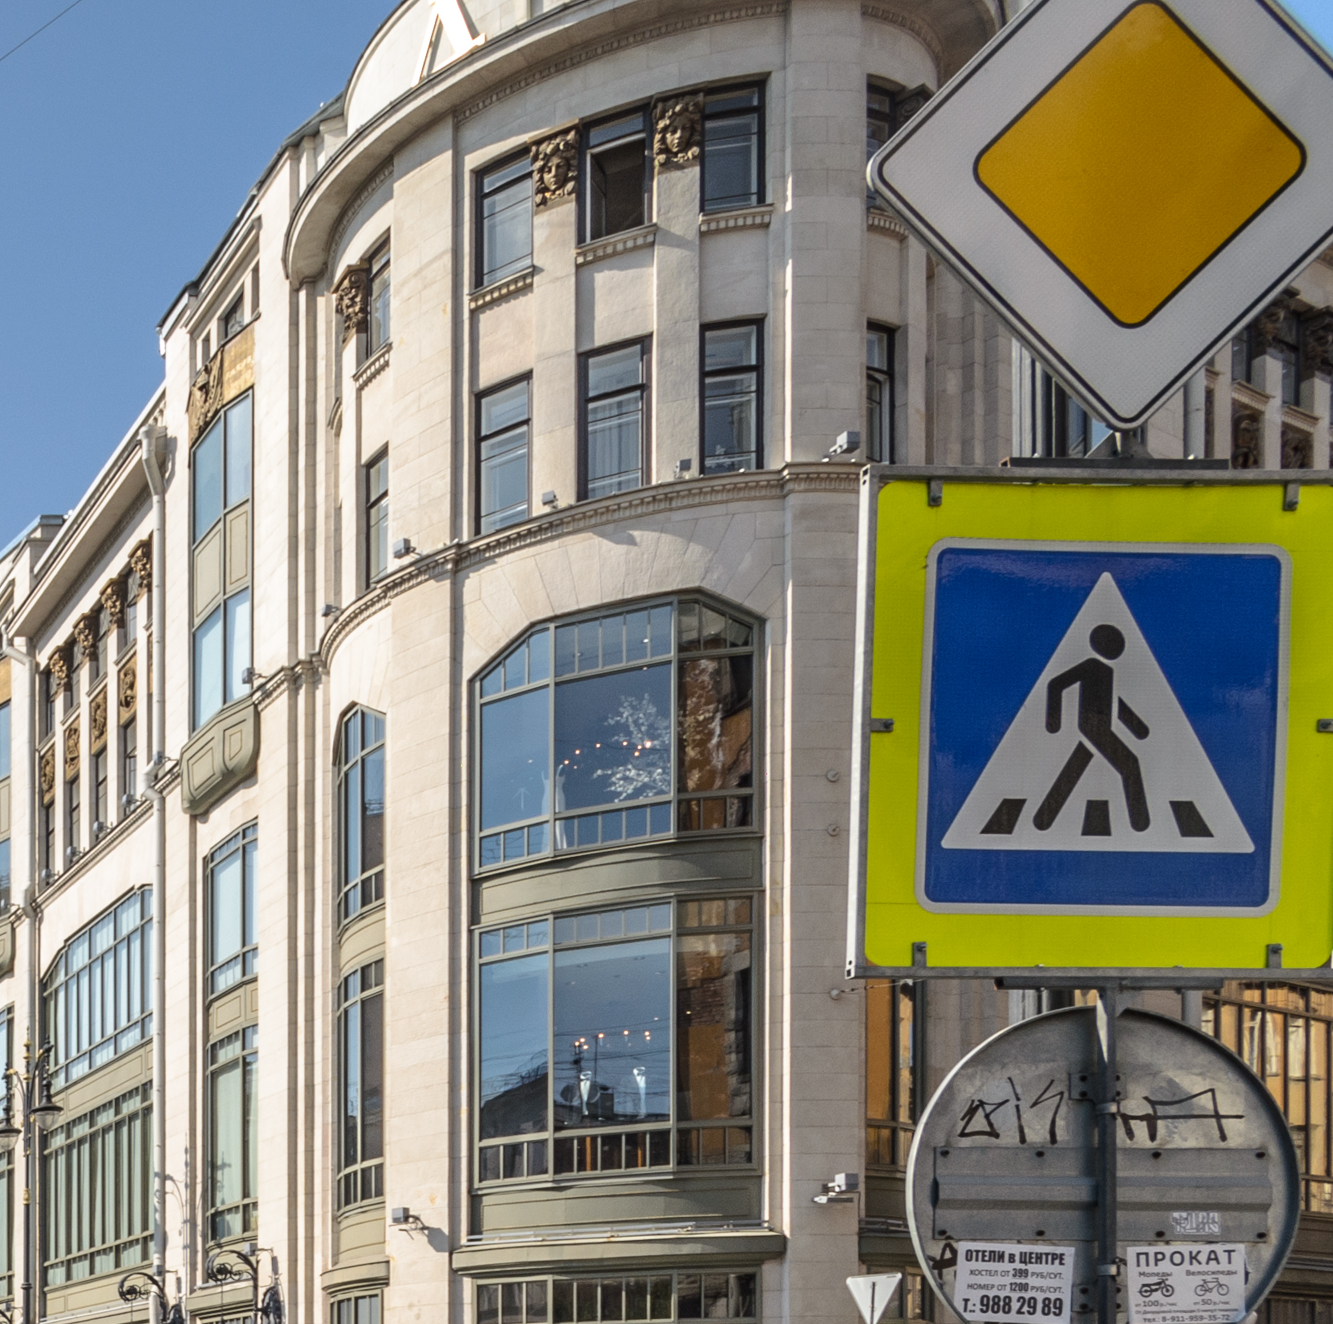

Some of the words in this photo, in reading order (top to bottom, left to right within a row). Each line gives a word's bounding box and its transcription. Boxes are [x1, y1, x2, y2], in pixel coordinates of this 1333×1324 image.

[965, 1249, 1005, 1263] ОТЕЛИ
[1008, 1252, 1016, 1263] в
[1020, 1251, 1065, 1266] ЦЕНТРЕ
[1135, 1249, 1236, 1267] ПРОКАТ
[969, 1268, 998, 1277] ХОСТЕЛ
[1000, 1270, 1010, 1278] ОТ
[1012, 1268, 1029, 1279] 399
[1030, 1271, 1064, 1280] РУБ/СУТ.
[1185, 1269, 1238, 1277] Велосипеды
[967, 1282, 995, 1291] НОМЕР
[1009, 1282, 1029, 1293] 1200
[1030, 1285, 1064, 1294] РУБ/СУТ.
[979, 1294, 1012, 1315] 988
[1016, 1296, 1037, 1316] 29
[1041, 1297, 1064, 1317] 89
[1161, 1314, 1230, 1323] 8-911-959-35-72
